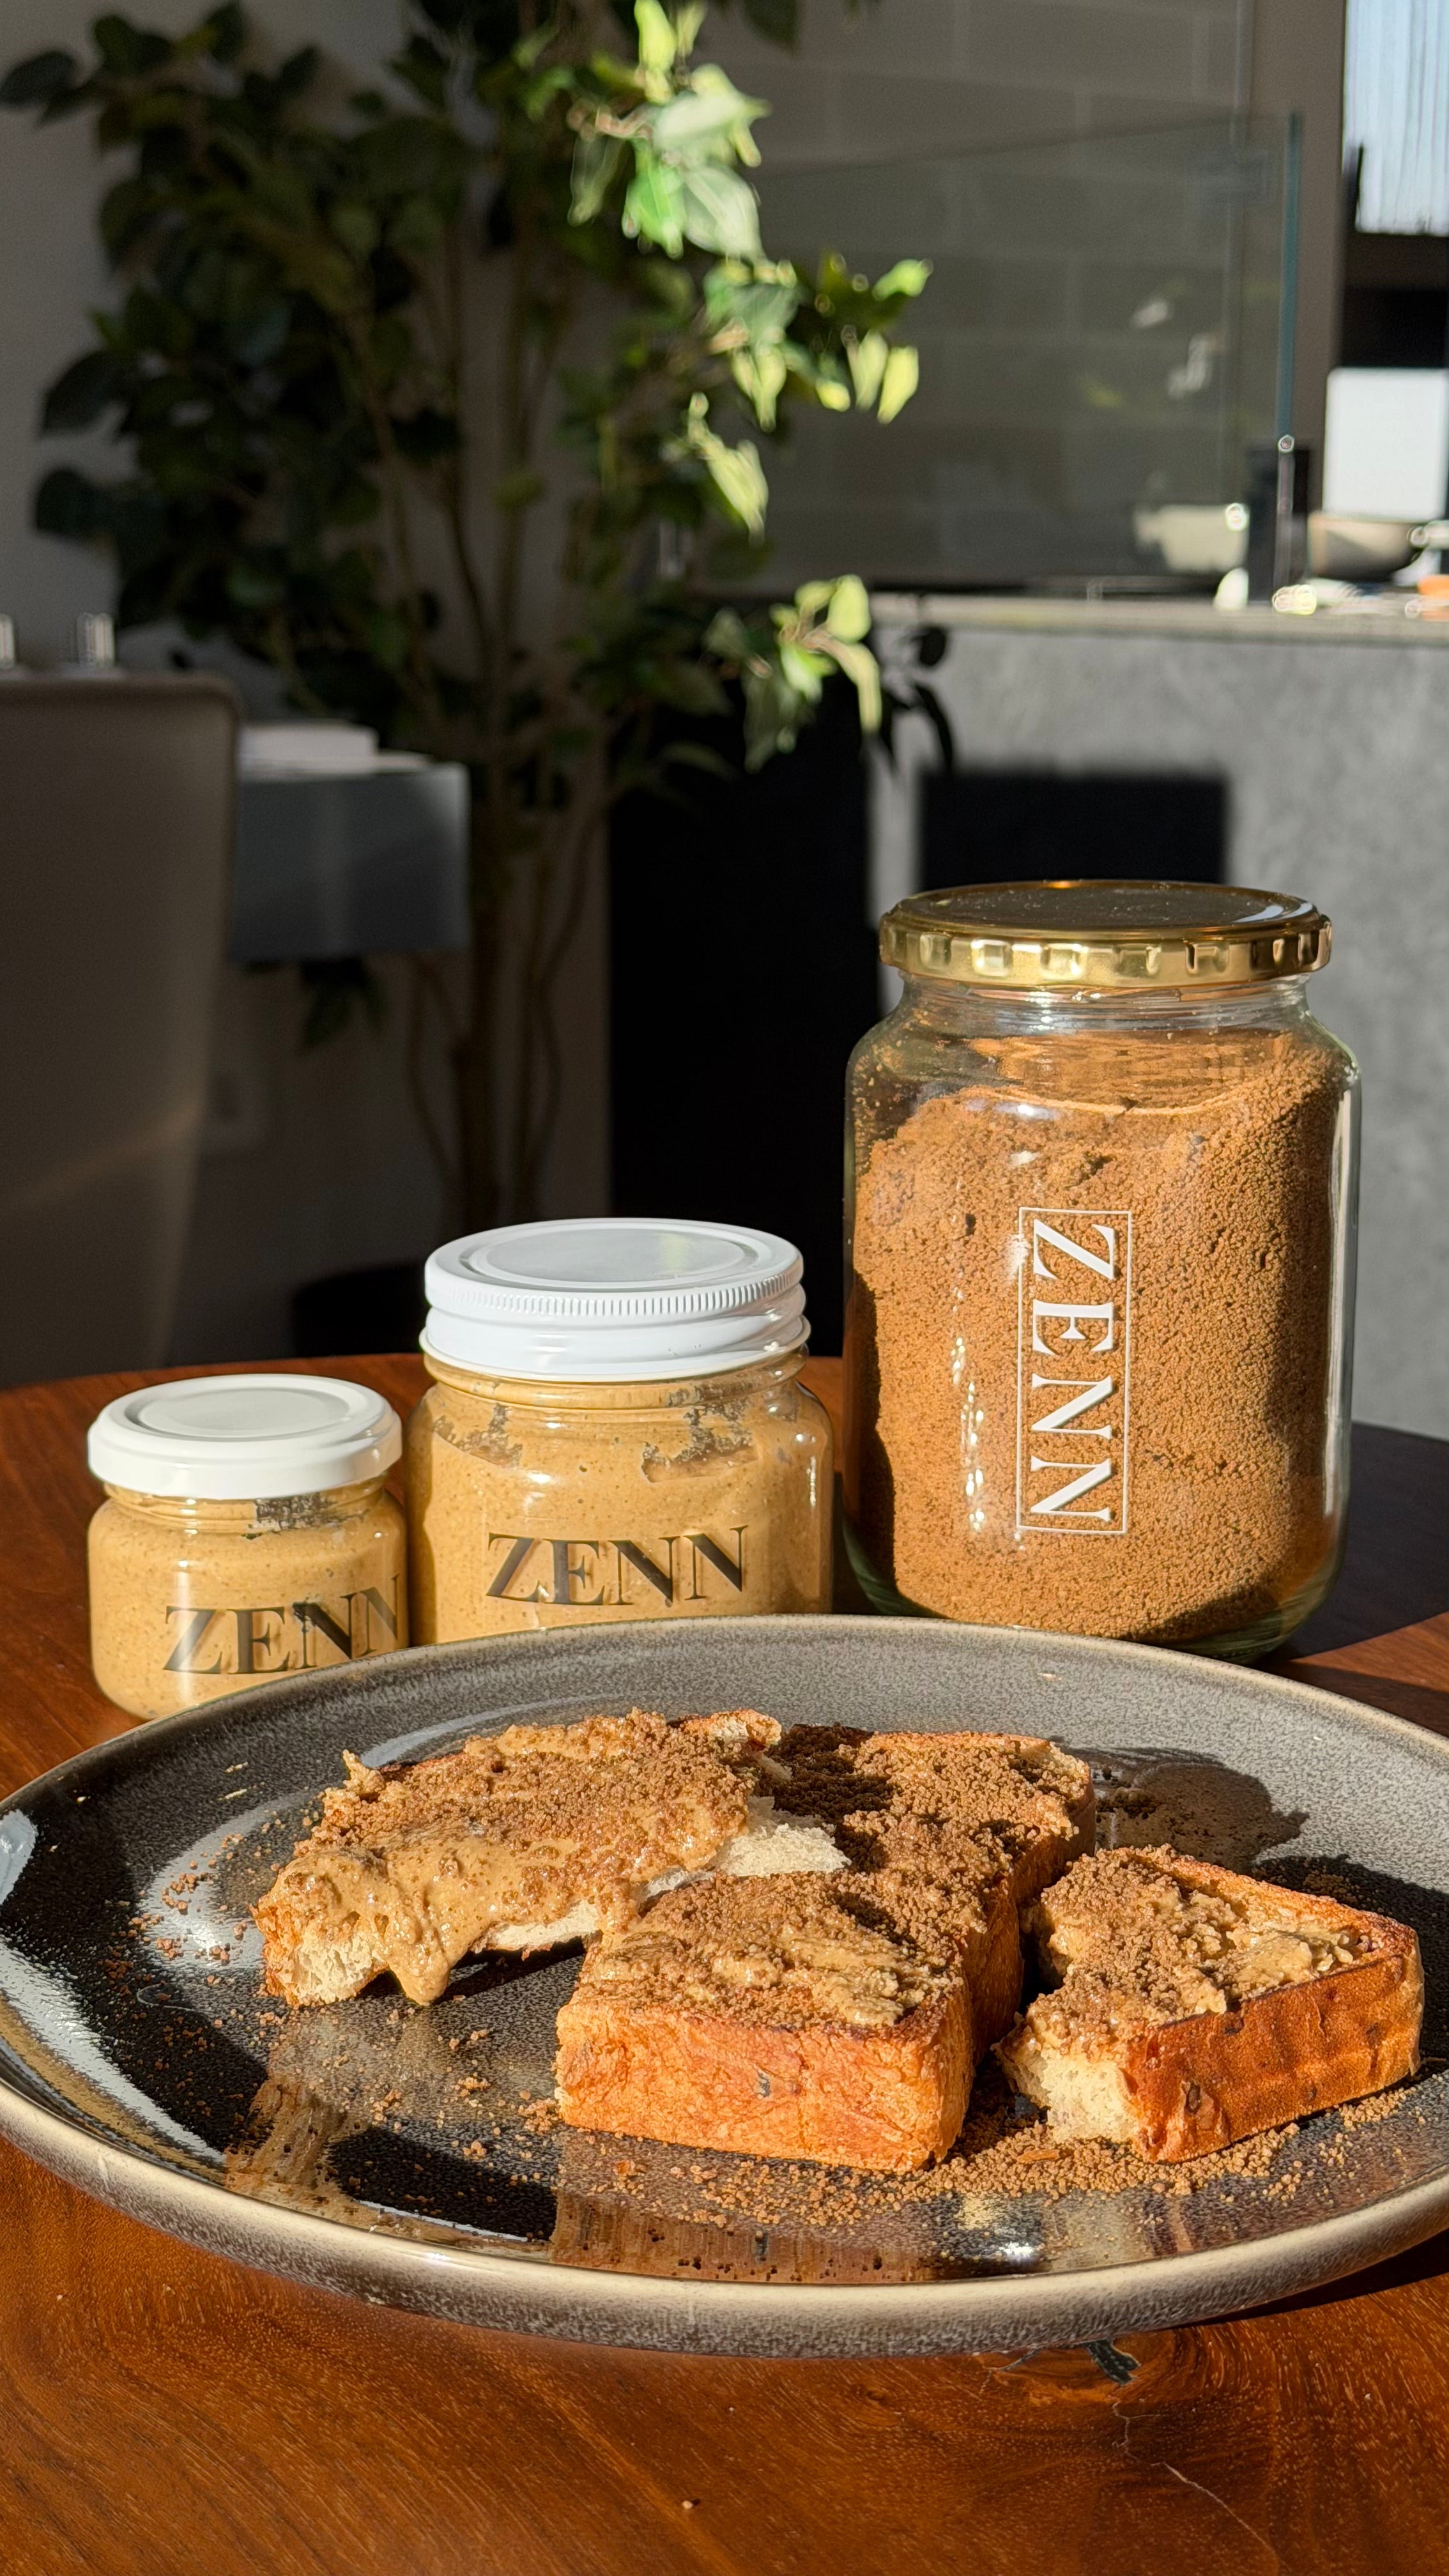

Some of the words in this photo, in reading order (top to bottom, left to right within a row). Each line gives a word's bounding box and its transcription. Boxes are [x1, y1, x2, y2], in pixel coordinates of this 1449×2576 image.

[1030, 1218, 1114, 1522] ZENN
[486, 1524, 749, 1607] ZENN
[162, 1574, 400, 1675] ZENN
